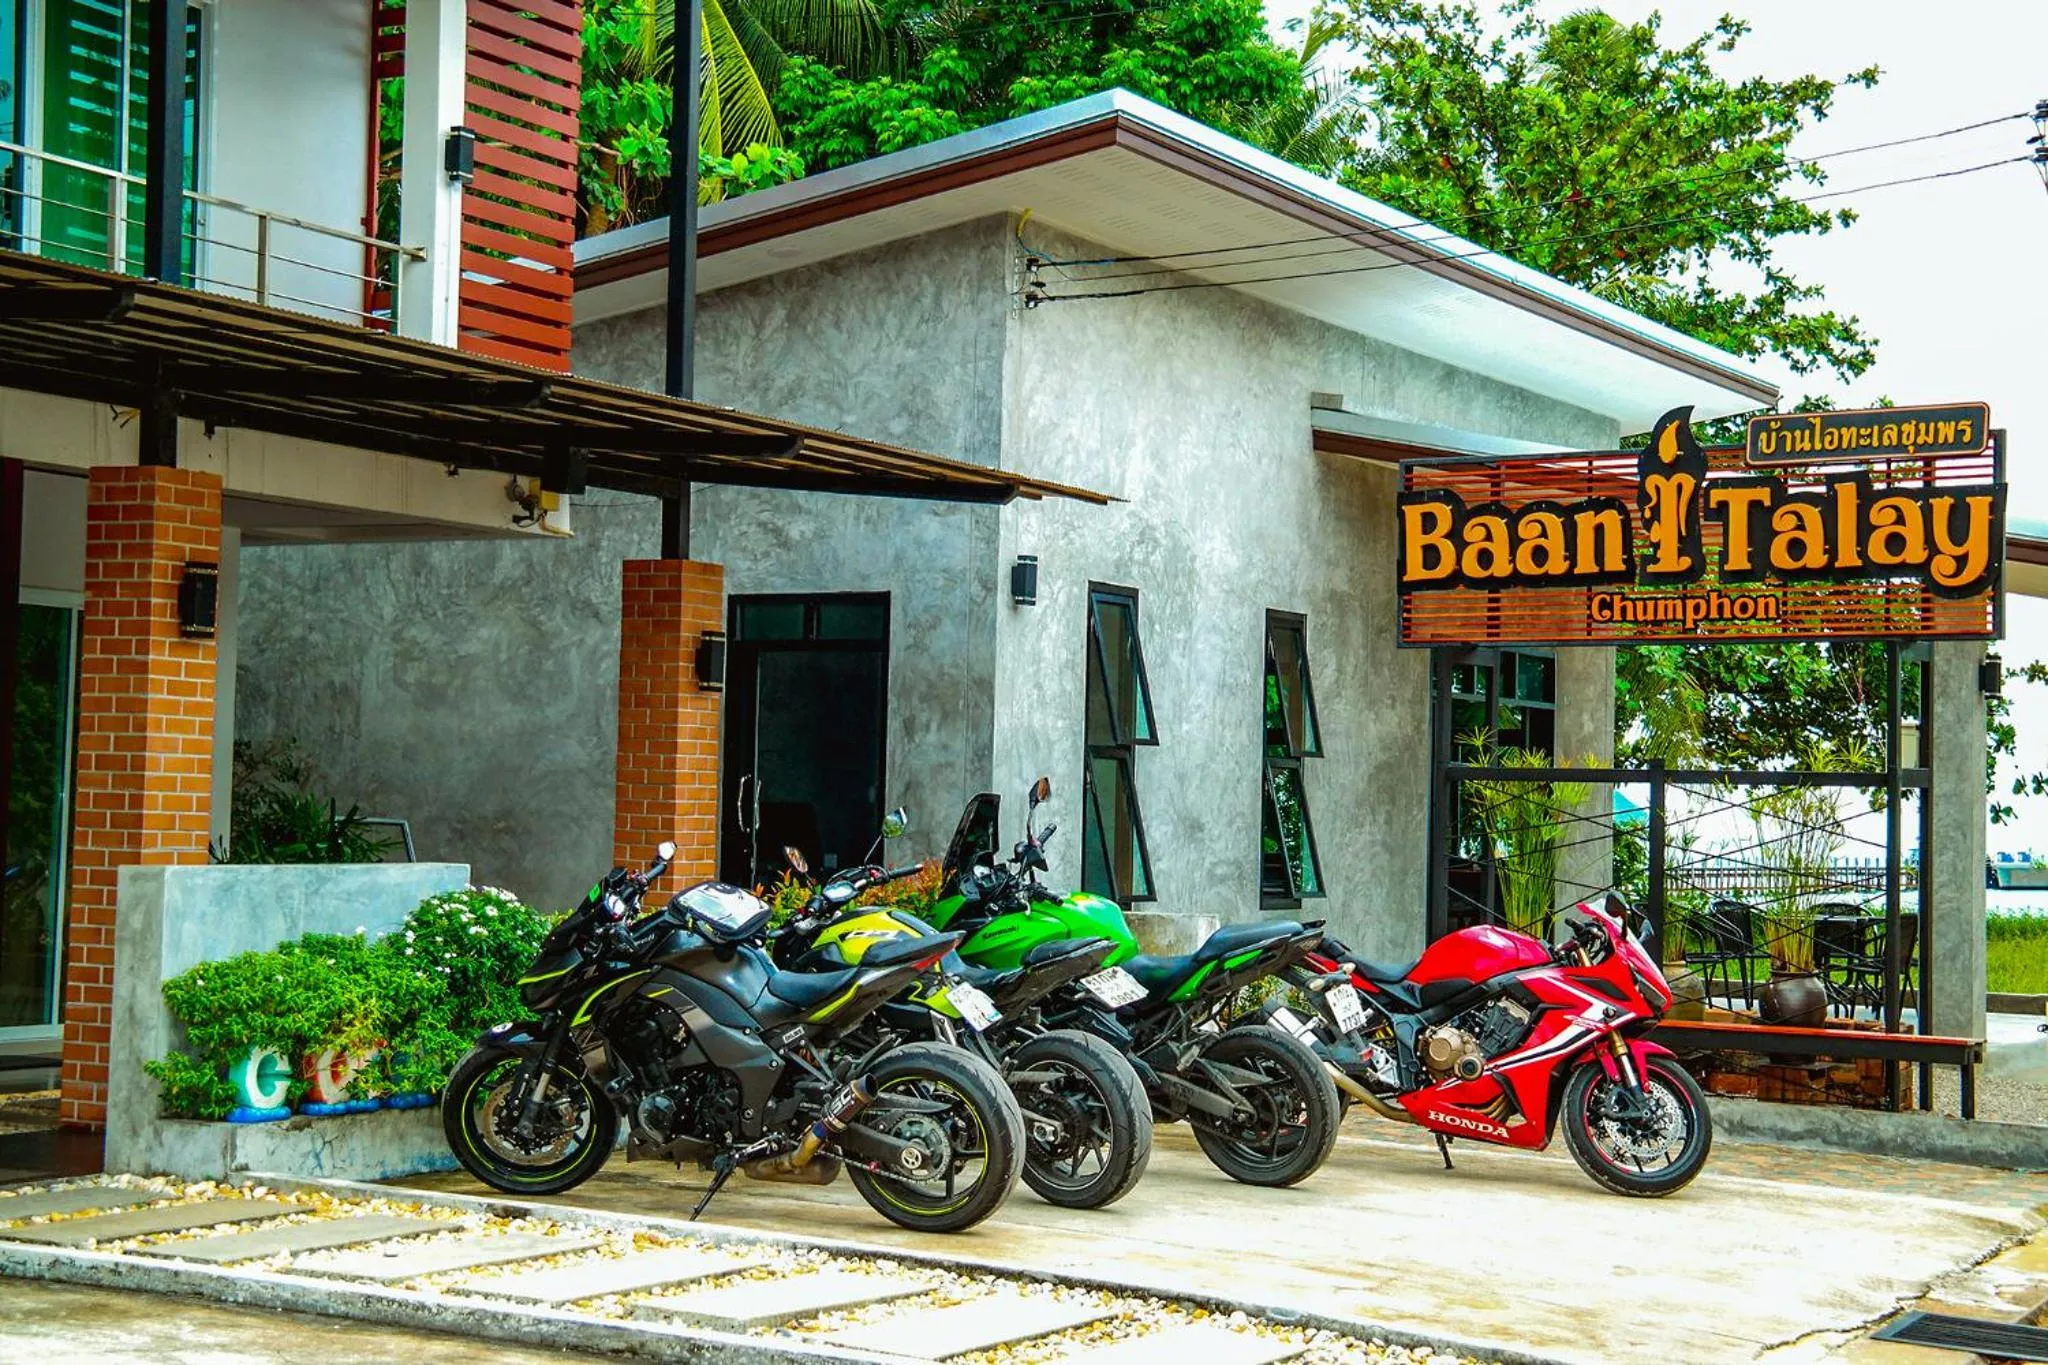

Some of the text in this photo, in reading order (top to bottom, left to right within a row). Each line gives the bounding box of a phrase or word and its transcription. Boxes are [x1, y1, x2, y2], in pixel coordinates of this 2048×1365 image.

[1759, 416, 1972, 455] บ้านไอทะเลชุมพร
[1402, 501, 1627, 582] Baan
[1709, 482, 1993, 587] Talay
[1590, 591, 1779, 630] Chumphon
[1428, 1109, 1510, 1139] HONDA
